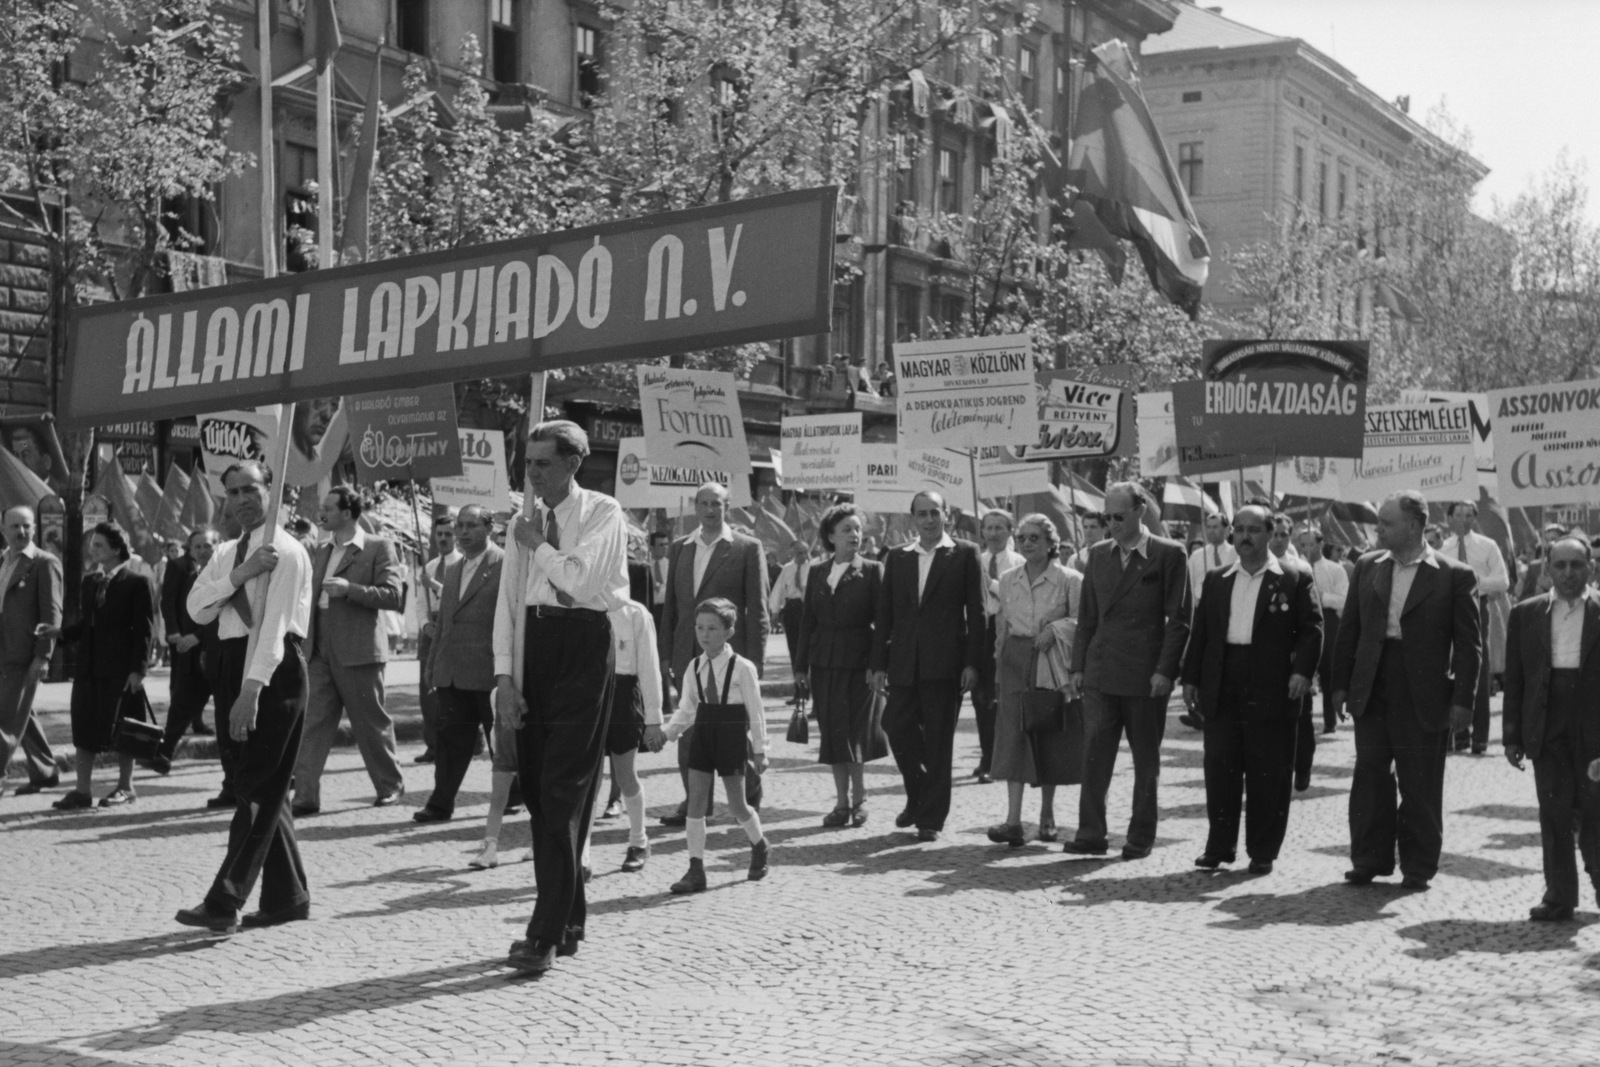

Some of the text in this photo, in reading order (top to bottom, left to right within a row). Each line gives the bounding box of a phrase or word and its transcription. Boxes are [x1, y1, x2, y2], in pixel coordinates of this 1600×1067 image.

[122, 293, 311, 394] ÁLLAMI
[339, 235, 612, 365] LAPKIADÓ
[708, 224, 746, 311] V.
[901, 351, 1026, 378] MAGYAR KÖZLÖNY
[394, 396, 419, 408] EMBER
[905, 395, 1026, 411] A DEMOKRATIKUS JOGREND
[1064, 385, 1111, 407] Vicc
[1205, 374, 1358, 415] ERDŐGAZDASÁG
[437, 410, 447, 421] AZ
[656, 398, 733, 438] Forum
[1053, 410, 1107, 421] REJTVÉNY
[922, 453, 950, 468] HARCOS
[867, 464, 893, 476] IPARI
[928, 467, 963, 486] RIPORTLAP
